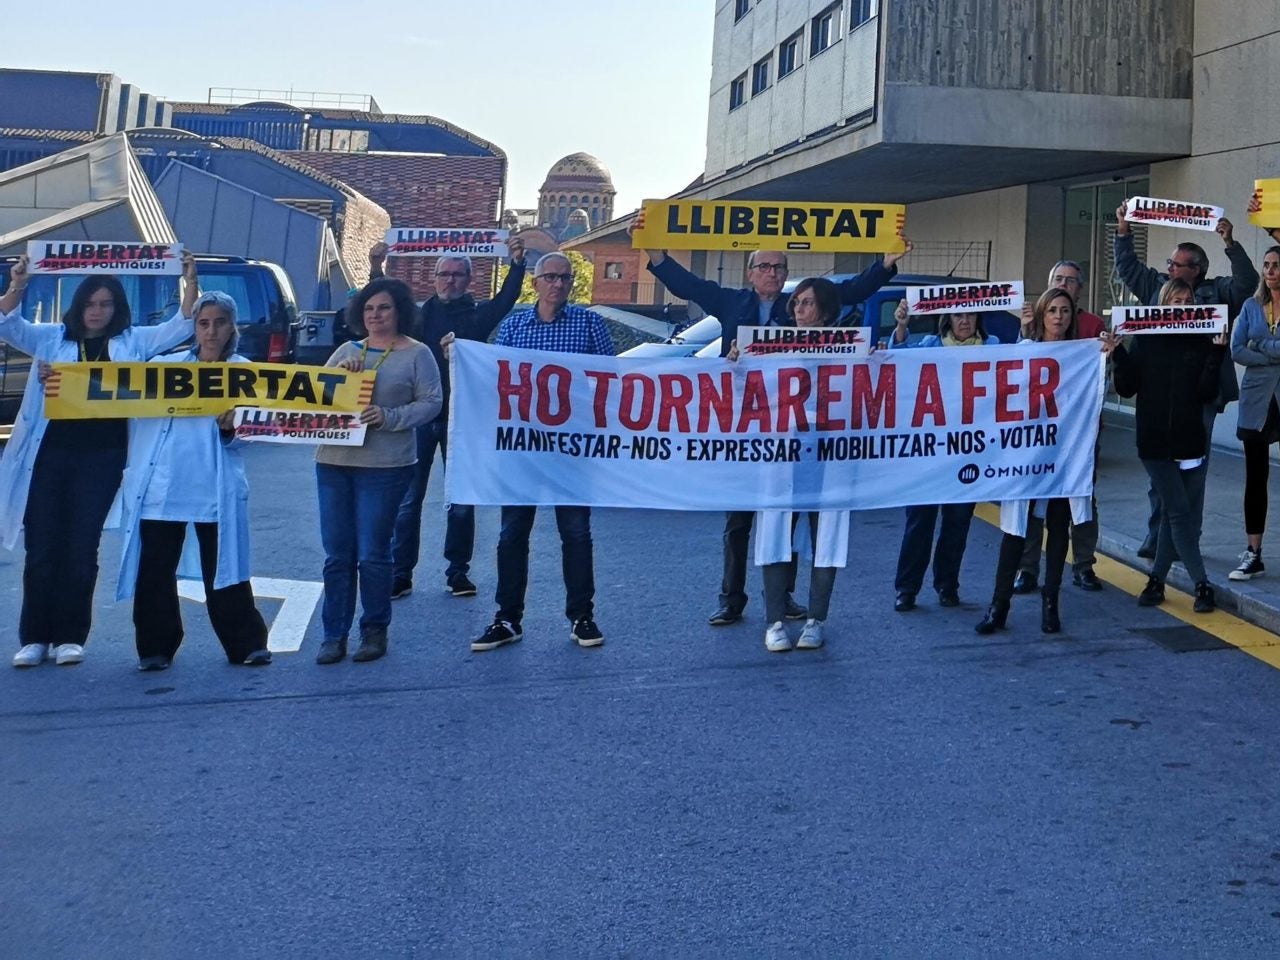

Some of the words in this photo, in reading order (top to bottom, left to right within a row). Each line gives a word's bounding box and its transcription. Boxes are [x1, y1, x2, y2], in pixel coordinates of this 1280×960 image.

[1135, 199, 1213, 219] LLIBERTAT
[667, 204, 884, 238] LLIBERTAT
[397, 230, 498, 244] LLIBERTAT
[45, 243, 168, 260] LLIBERTAT
[920, 284, 1012, 301] LLIBERTAT
[1125, 307, 1216, 321] LLIBERTAT
[752, 329, 859, 344] LLIBERTAT
[86, 367, 347, 406] LLIBERTAT
[497, 359, 572, 426] HO
[584, 363, 896, 434] TORNAREM
[911, 363, 946, 428] A
[962, 357, 1060, 424] FER
[241, 410, 355, 429] LLIBERTAT
[495, 427, 671, 461] MANIFESTAR-NOS
[687, 437, 800, 463] EXPRESSAR
[817, 429, 985, 462] MOBILITZAR-NOS
[1000, 423, 1058, 449] VOTAR
[984, 463, 1055, 478] ÒMNIUM
